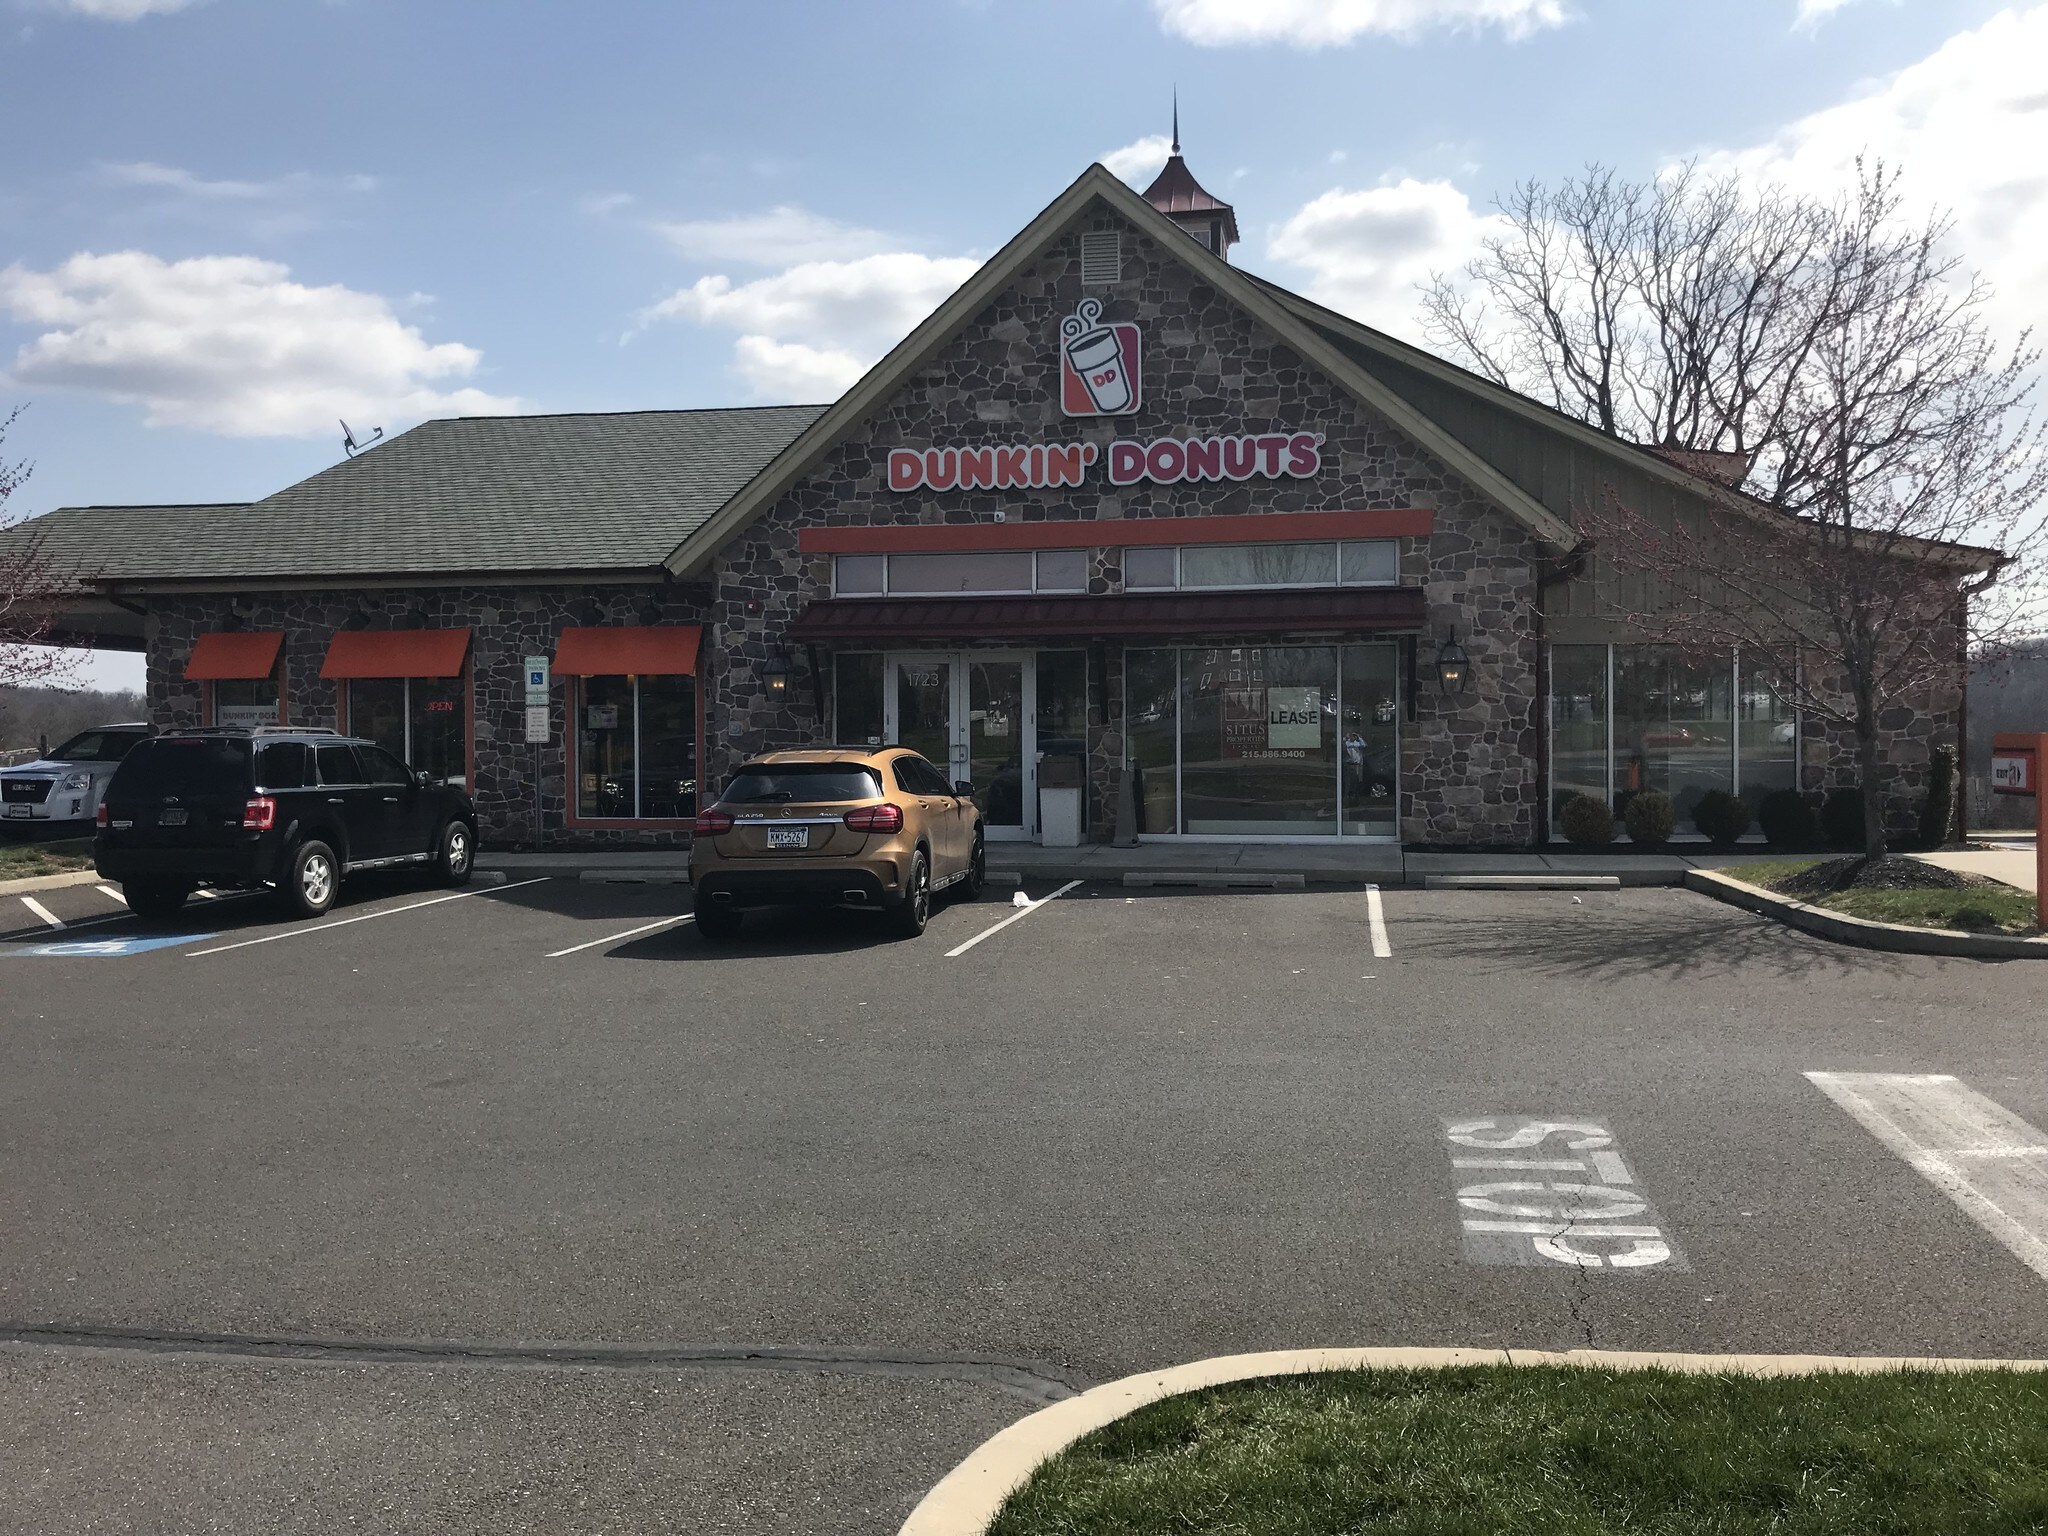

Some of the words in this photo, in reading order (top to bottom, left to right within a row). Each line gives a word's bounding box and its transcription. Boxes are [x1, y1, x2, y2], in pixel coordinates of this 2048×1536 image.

[1092, 368, 1117, 388] DD
[889, 446, 1095, 489] DUNKIN'
[1111, 434, 1319, 482] DONUTS
[908, 673, 939, 687] 1723
[1270, 711, 1318, 724] LEASE
[1226, 724, 1265, 735] SITUS
[1447, 1121, 1671, 1268] STOP
